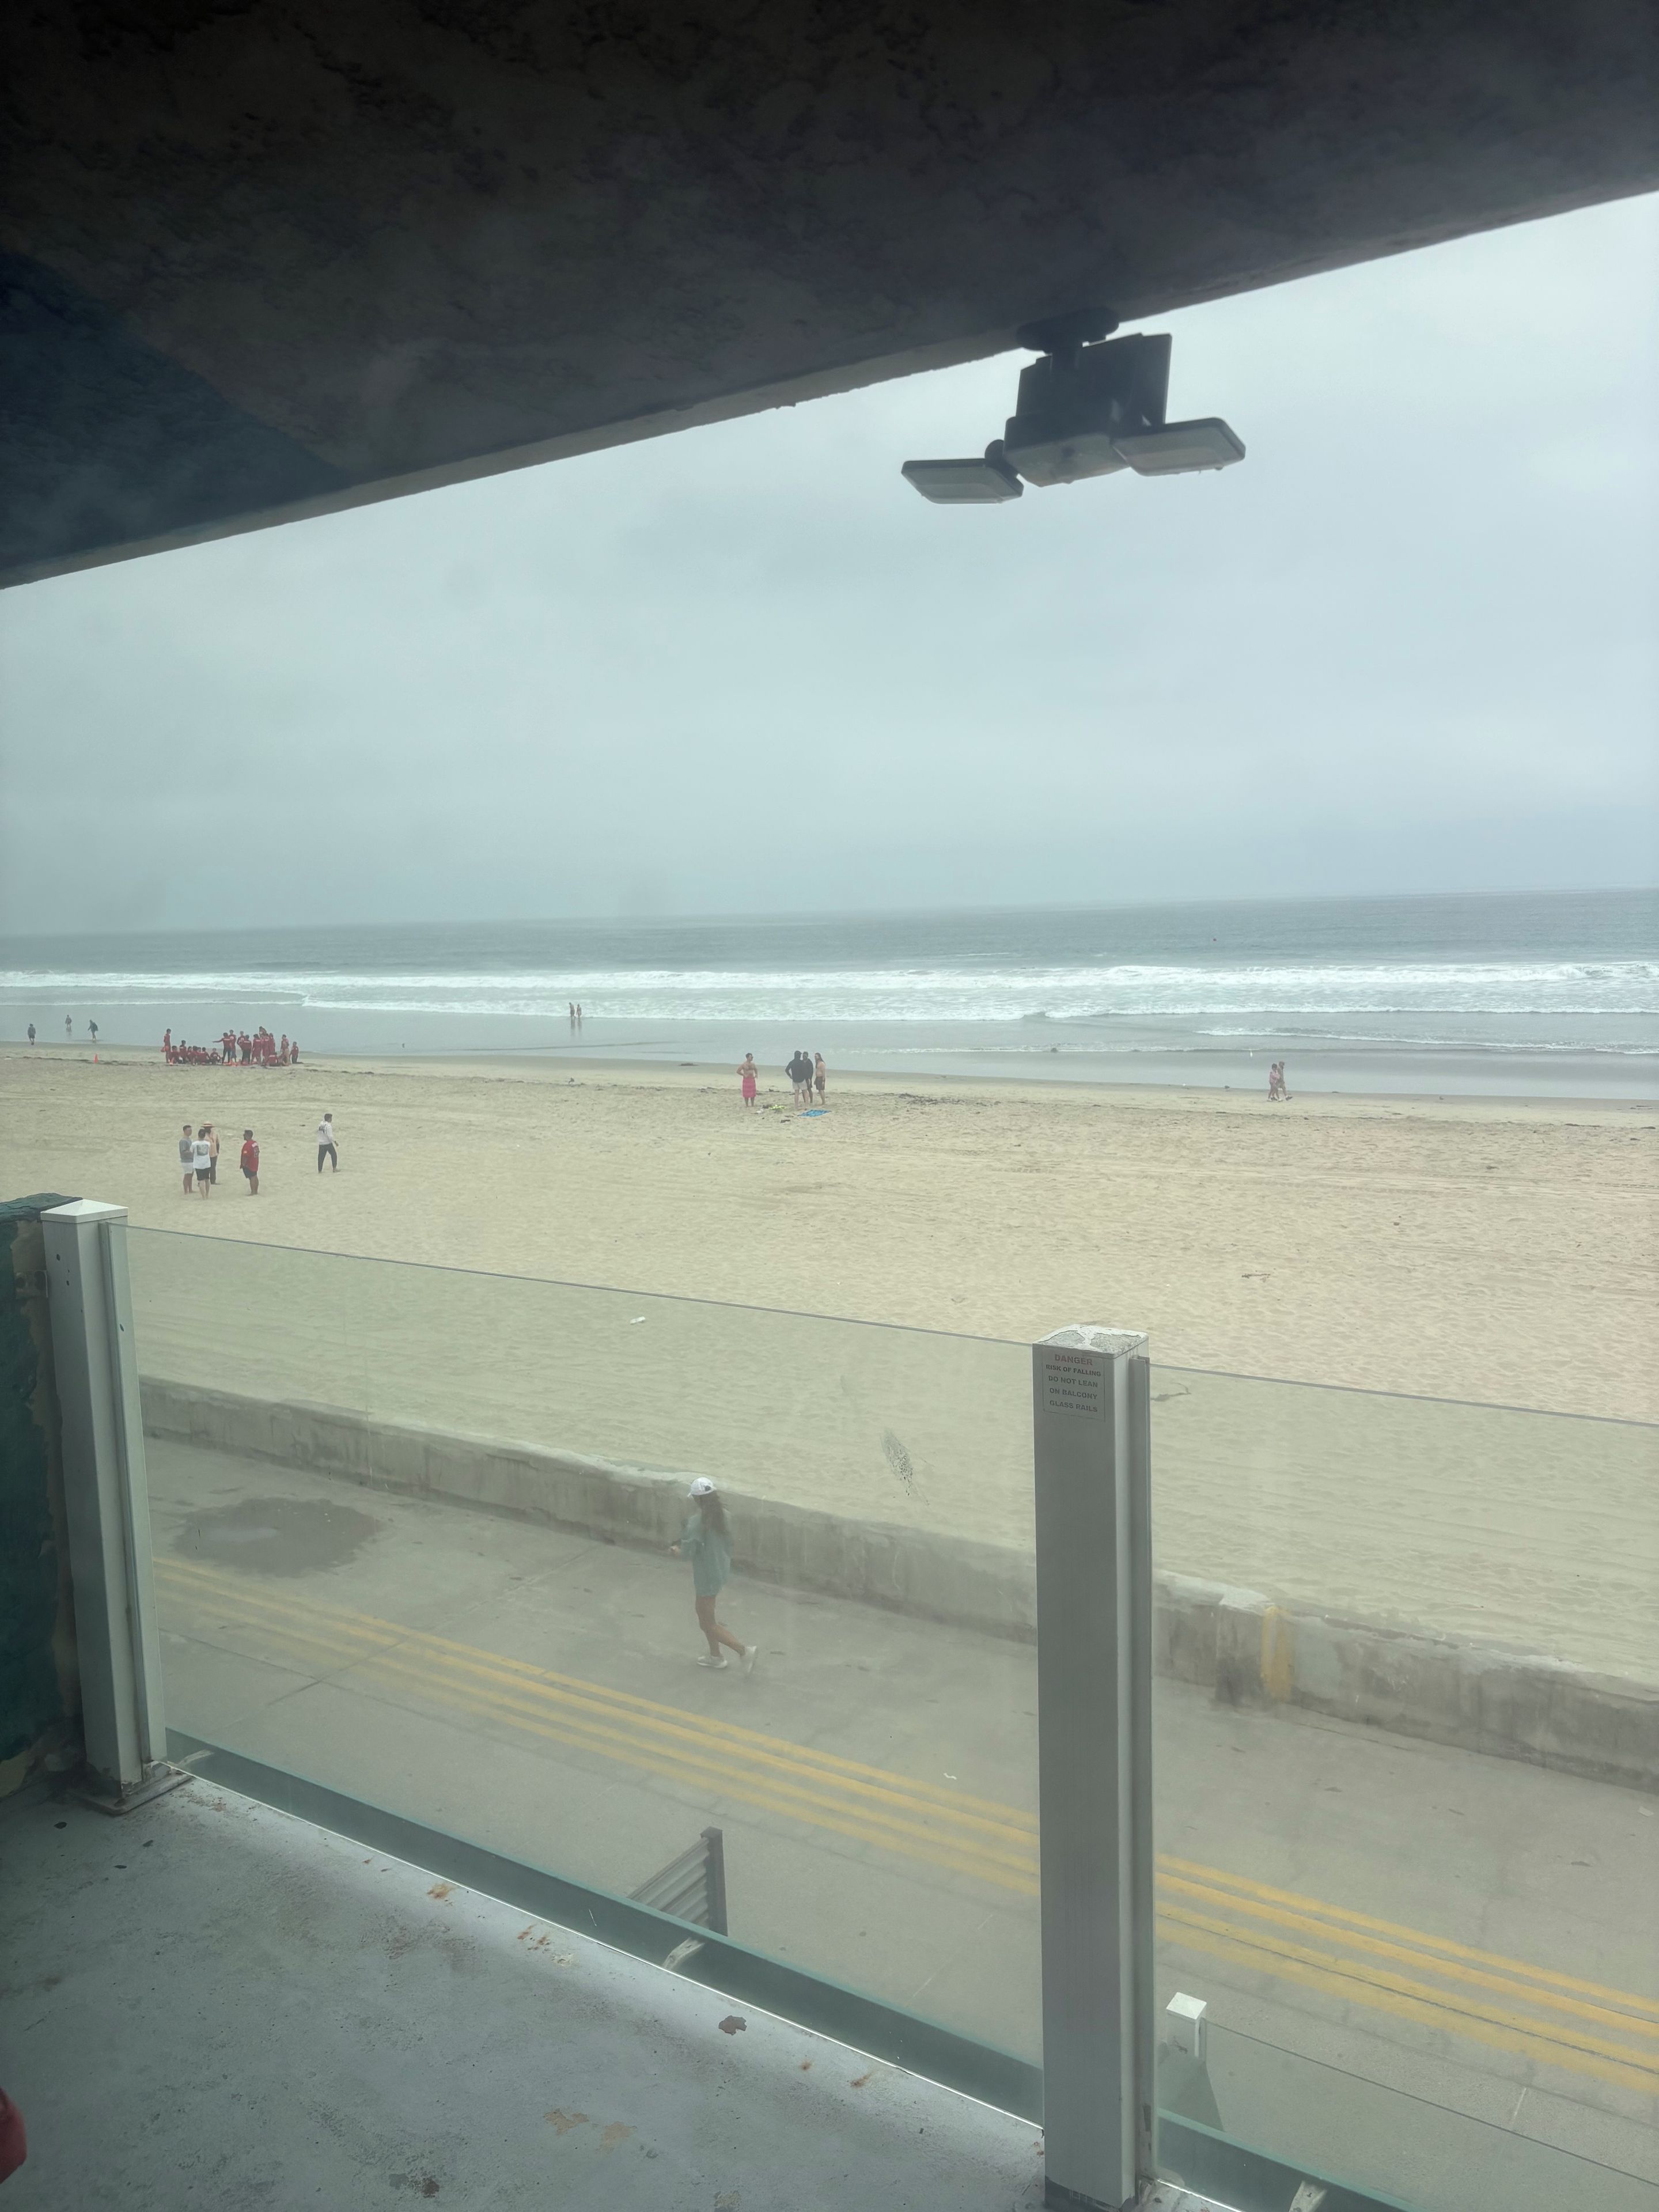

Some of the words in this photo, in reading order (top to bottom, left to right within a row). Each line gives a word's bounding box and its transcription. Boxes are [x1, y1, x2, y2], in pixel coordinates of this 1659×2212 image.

[1055, 1354, 1093, 1365] DANGER
[1073, 1368, 1101, 1377] FALLING
[1062, 1389, 1097, 1400] BALCONY
[1050, 1400, 1074, 1409] GLASS
[1075, 1404, 1097, 1412] RAILS
